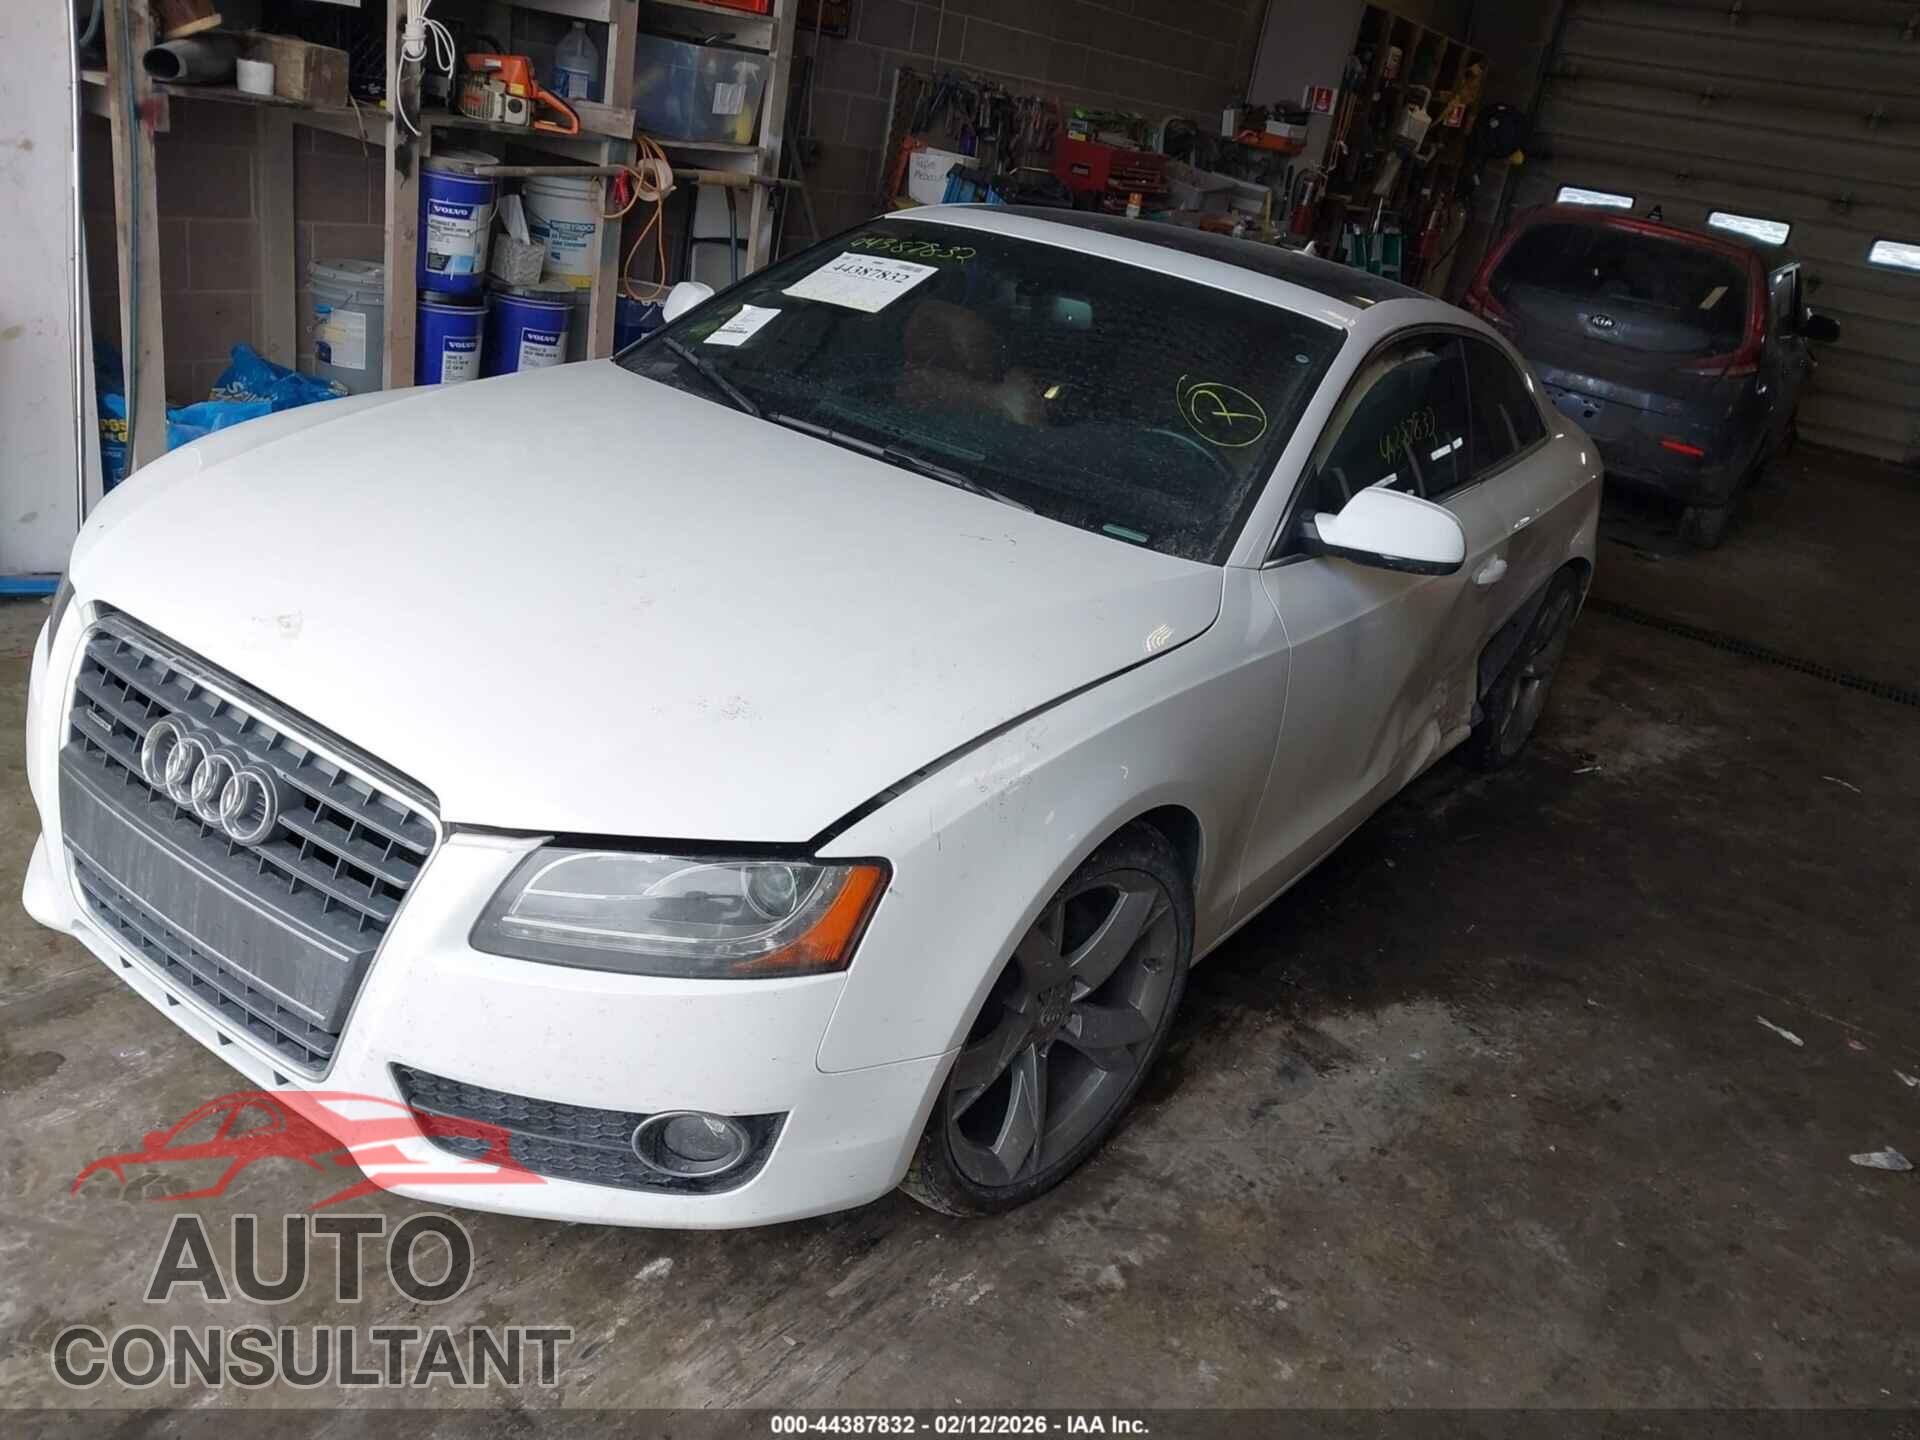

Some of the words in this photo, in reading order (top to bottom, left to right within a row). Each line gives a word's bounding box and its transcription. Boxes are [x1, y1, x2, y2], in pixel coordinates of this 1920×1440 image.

[432, 205, 469, 216] VOLVO
[832, 263, 910, 285] 44387832
[1592, 316, 1614, 327] KIA
[528, 333, 556, 343] VOLVO
[448, 341, 475, 349] VOLVO
